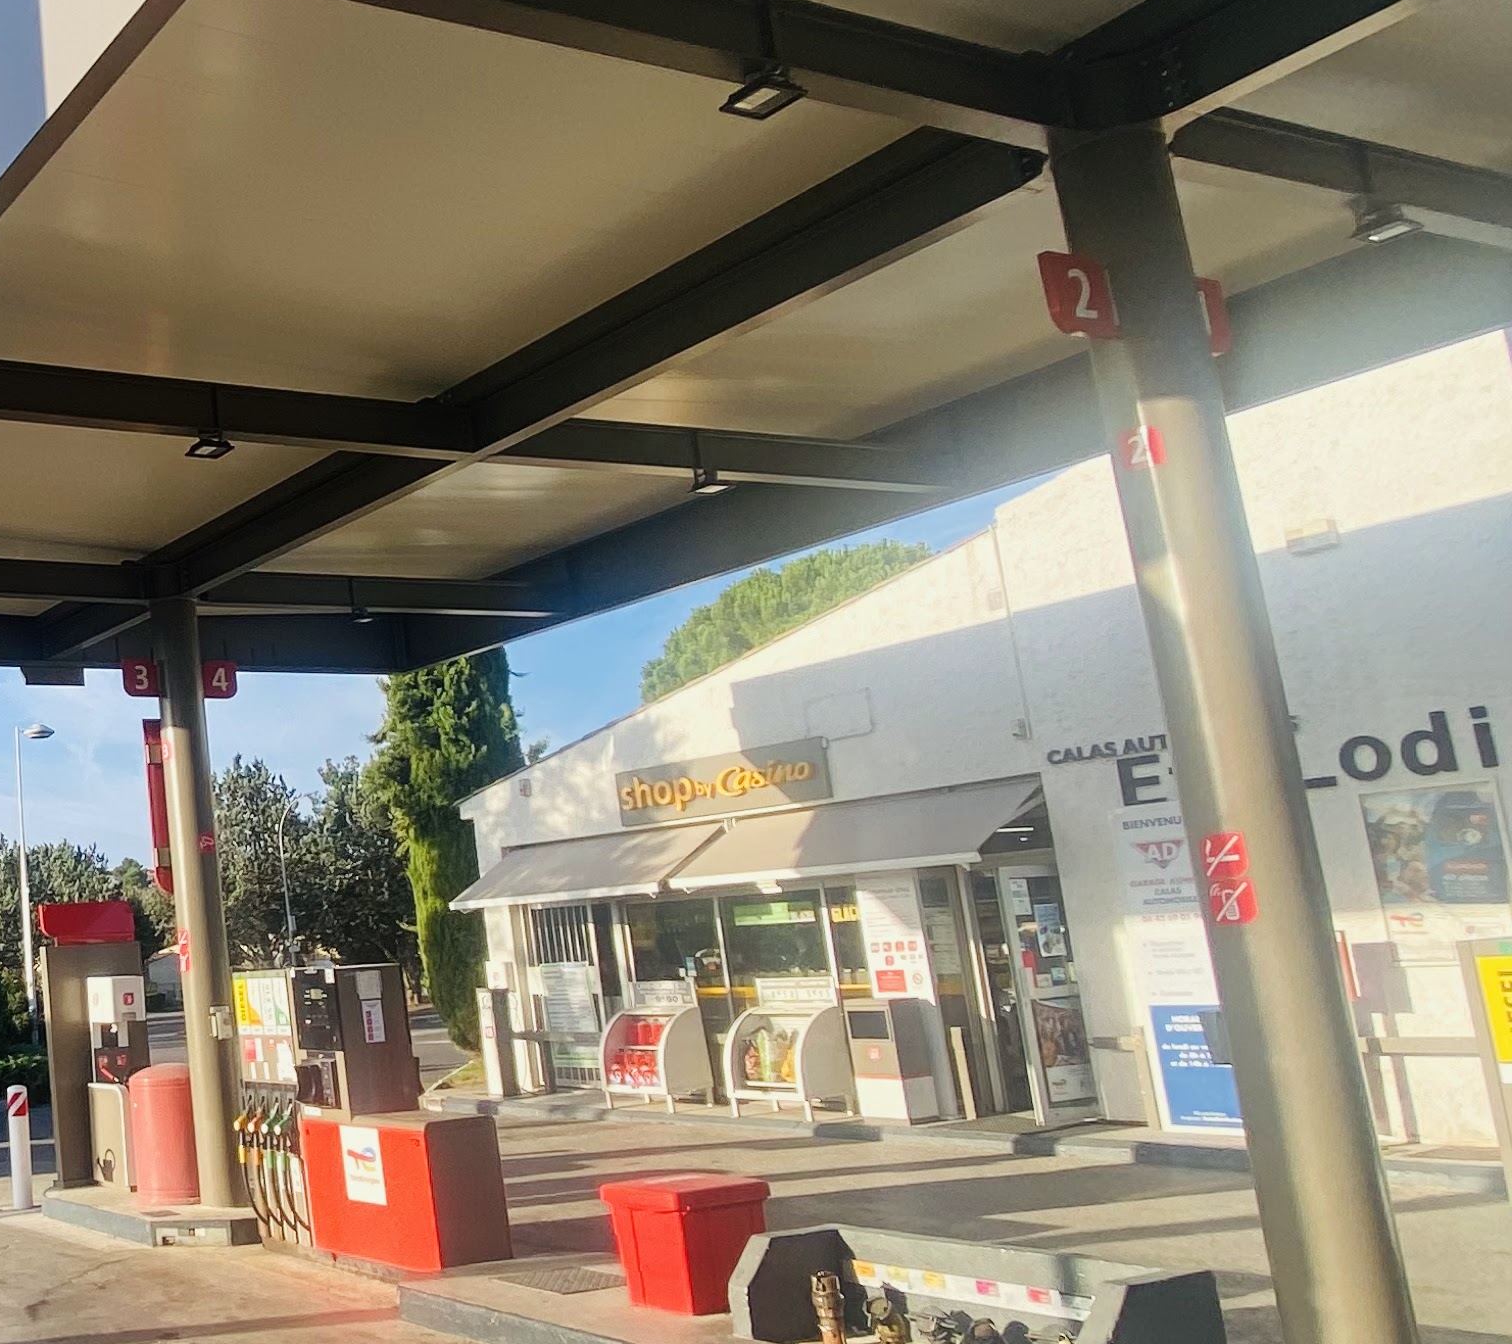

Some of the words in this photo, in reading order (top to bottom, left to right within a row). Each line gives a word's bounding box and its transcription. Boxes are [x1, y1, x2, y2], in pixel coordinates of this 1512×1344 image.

[1067, 268, 1099, 320] 2
[134, 664, 149, 690] 3
[212, 667, 229, 692] 4
[1047, 741, 1118, 765] CALAS
[1123, 733, 1168, 755] AUT
[621, 776, 696, 812] shop
[716, 760, 811, 798] Casino
